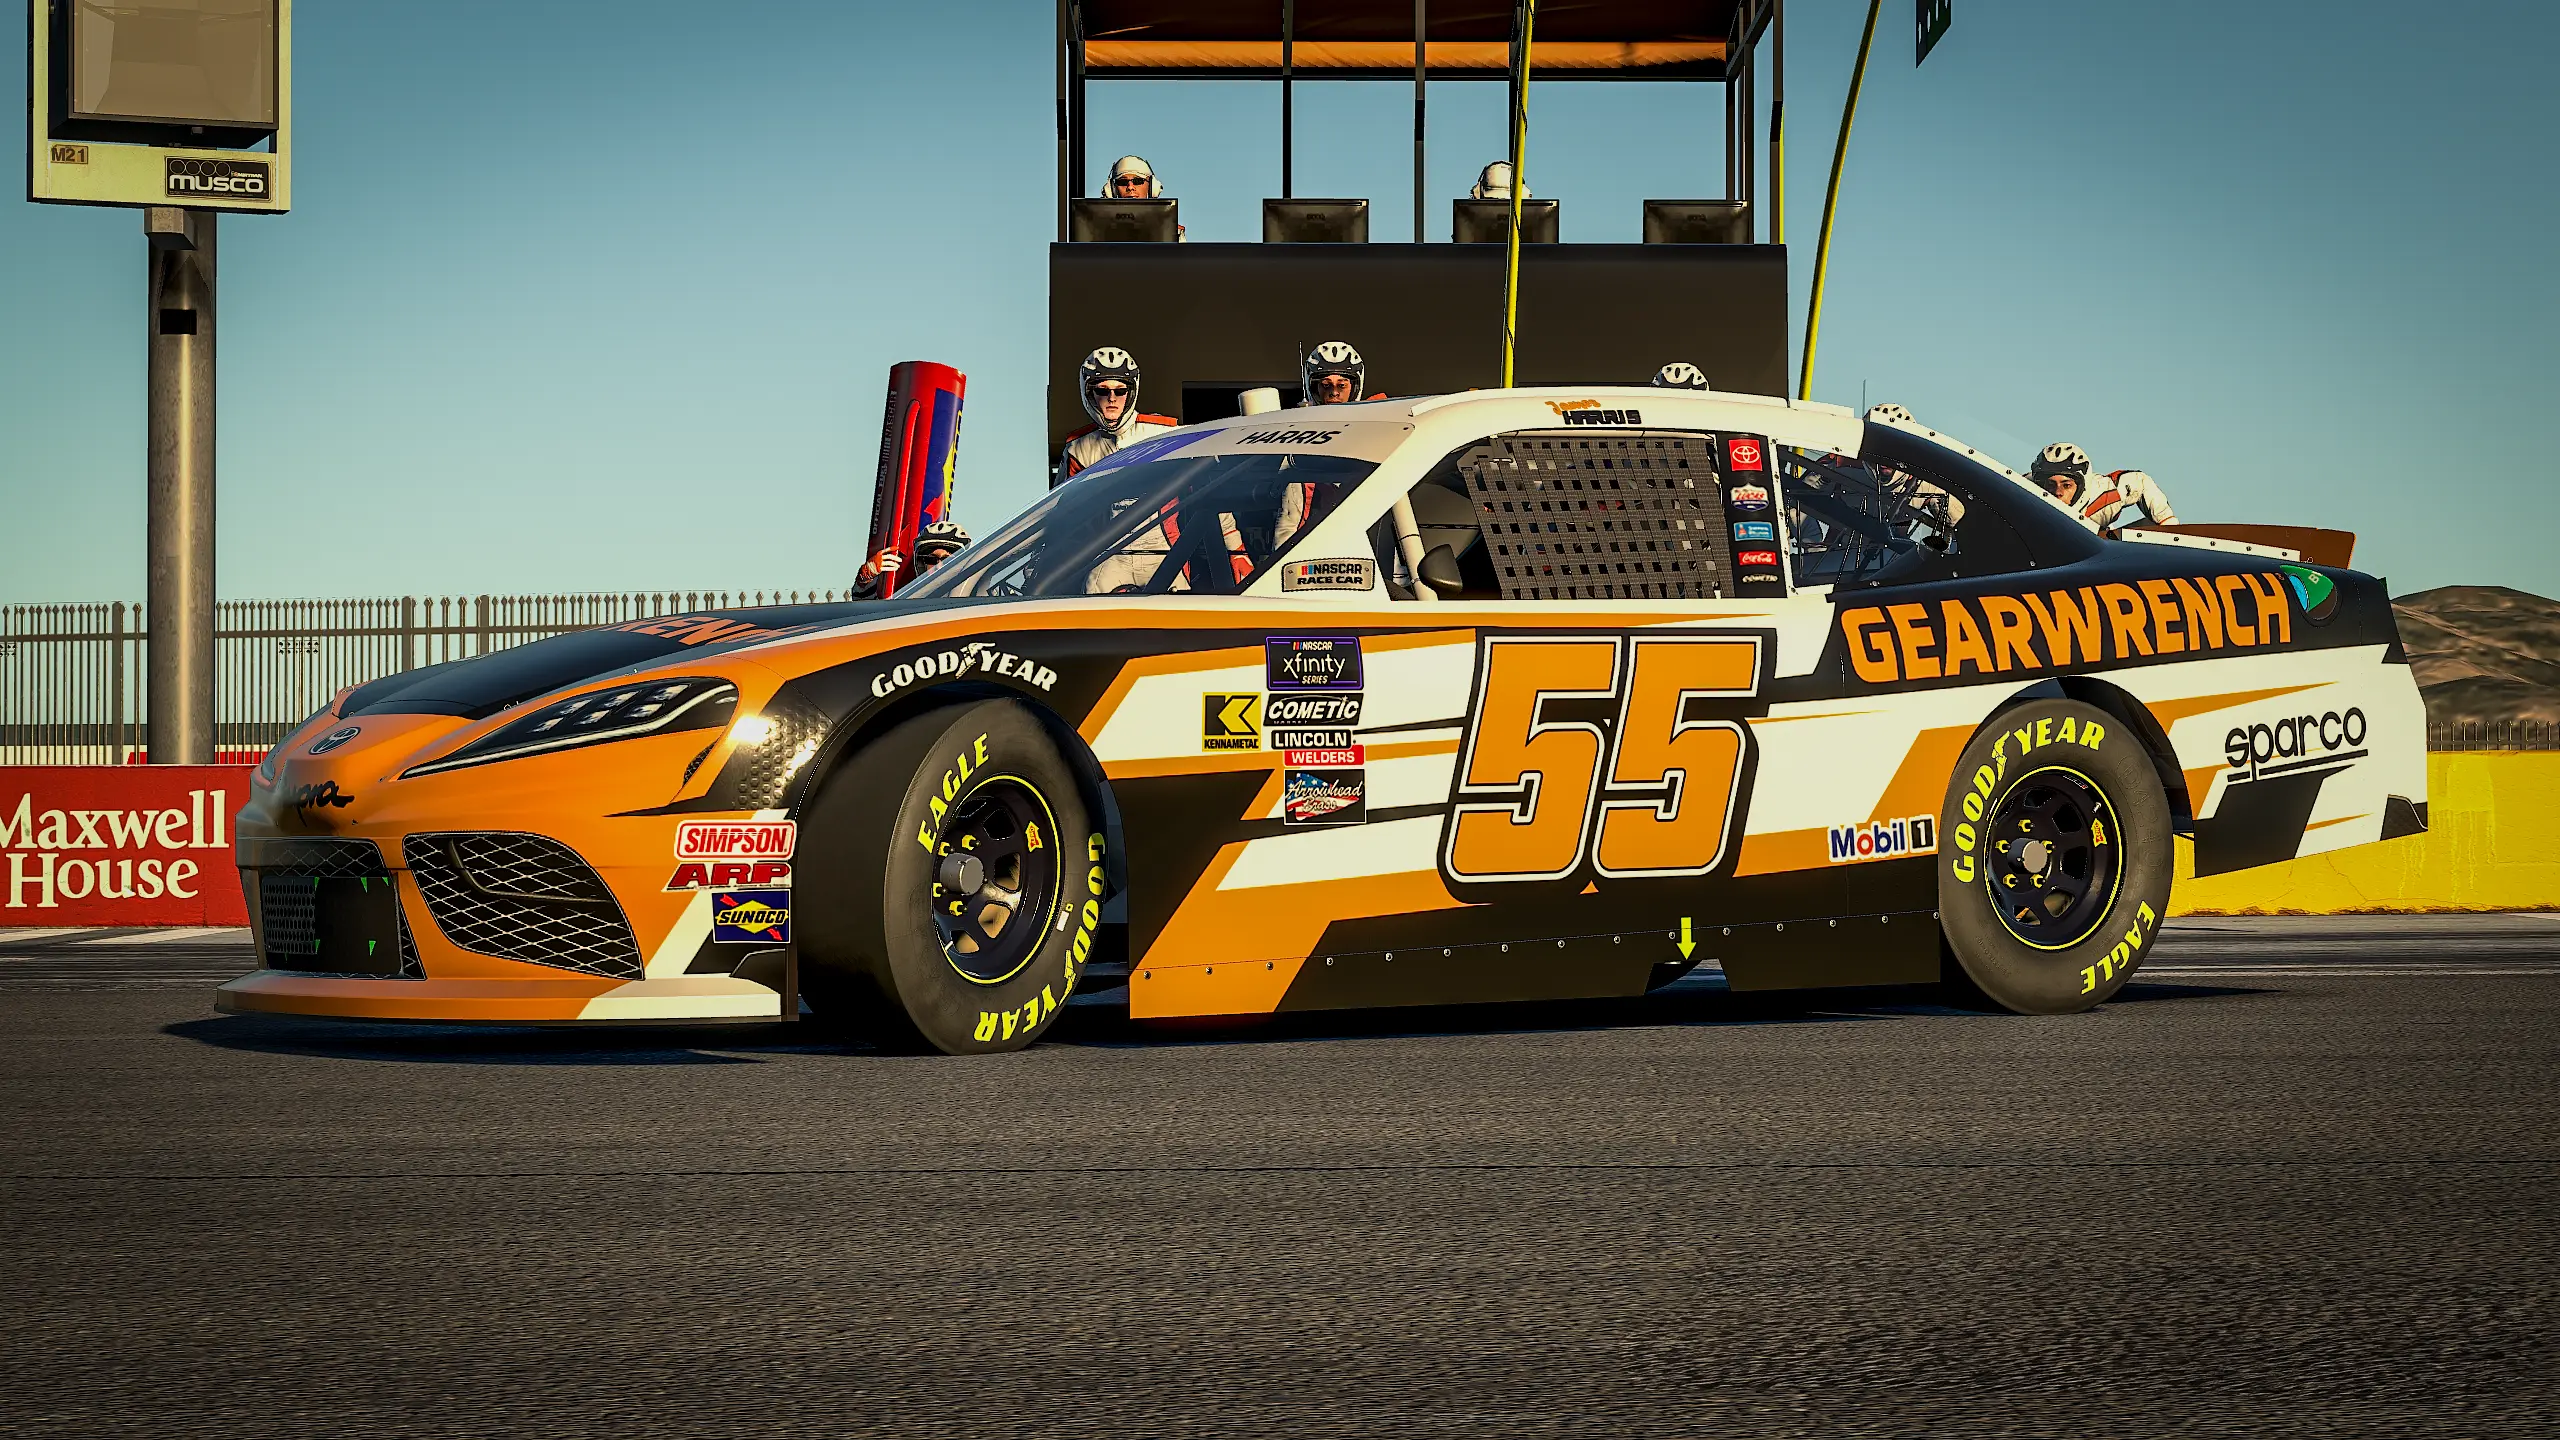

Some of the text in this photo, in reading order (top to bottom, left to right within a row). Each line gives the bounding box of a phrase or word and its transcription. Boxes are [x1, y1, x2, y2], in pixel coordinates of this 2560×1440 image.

[51, 148, 86, 163] M21
[1562, 410, 1641, 425] HARRIS
[1235, 430, 1341, 446] HARRIS
[1297, 576, 1364, 586] RACE CAR
[1313, 563, 1363, 576] NASCAR
[1841, 572, 2291, 685] GEARWRENCH
[1301, 641, 1333, 650] NASCAR
[871, 641, 1058, 698] GOODYEAR
[1282, 652, 1346, 679] xfinity
[1301, 675, 1328, 685] SERIES
[1268, 699, 1360, 720] COMETIC
[1204, 738, 1259, 749] KENNAMETAL
[1275, 732, 1347, 747] LINCOLN
[2224, 706, 2367, 782] sparco
[1291, 751, 1355, 764] WELDERS
[1445, 635, 1763, 884] 55
[917, 732, 989, 854] EAGLE
[1285, 779, 1363, 799] Arrowhead
[1953, 716, 2106, 884] GOODYEAR
[0, 789, 230, 850] Maxwell
[685, 827, 788, 853] SIMPSON
[1831, 818, 1906, 860] Mobil
[5, 852, 199, 908] House
[667, 862, 791, 888] ARP
[718, 910, 788, 925] SUNOCO
[2080, 899, 2157, 995] EAGLE
